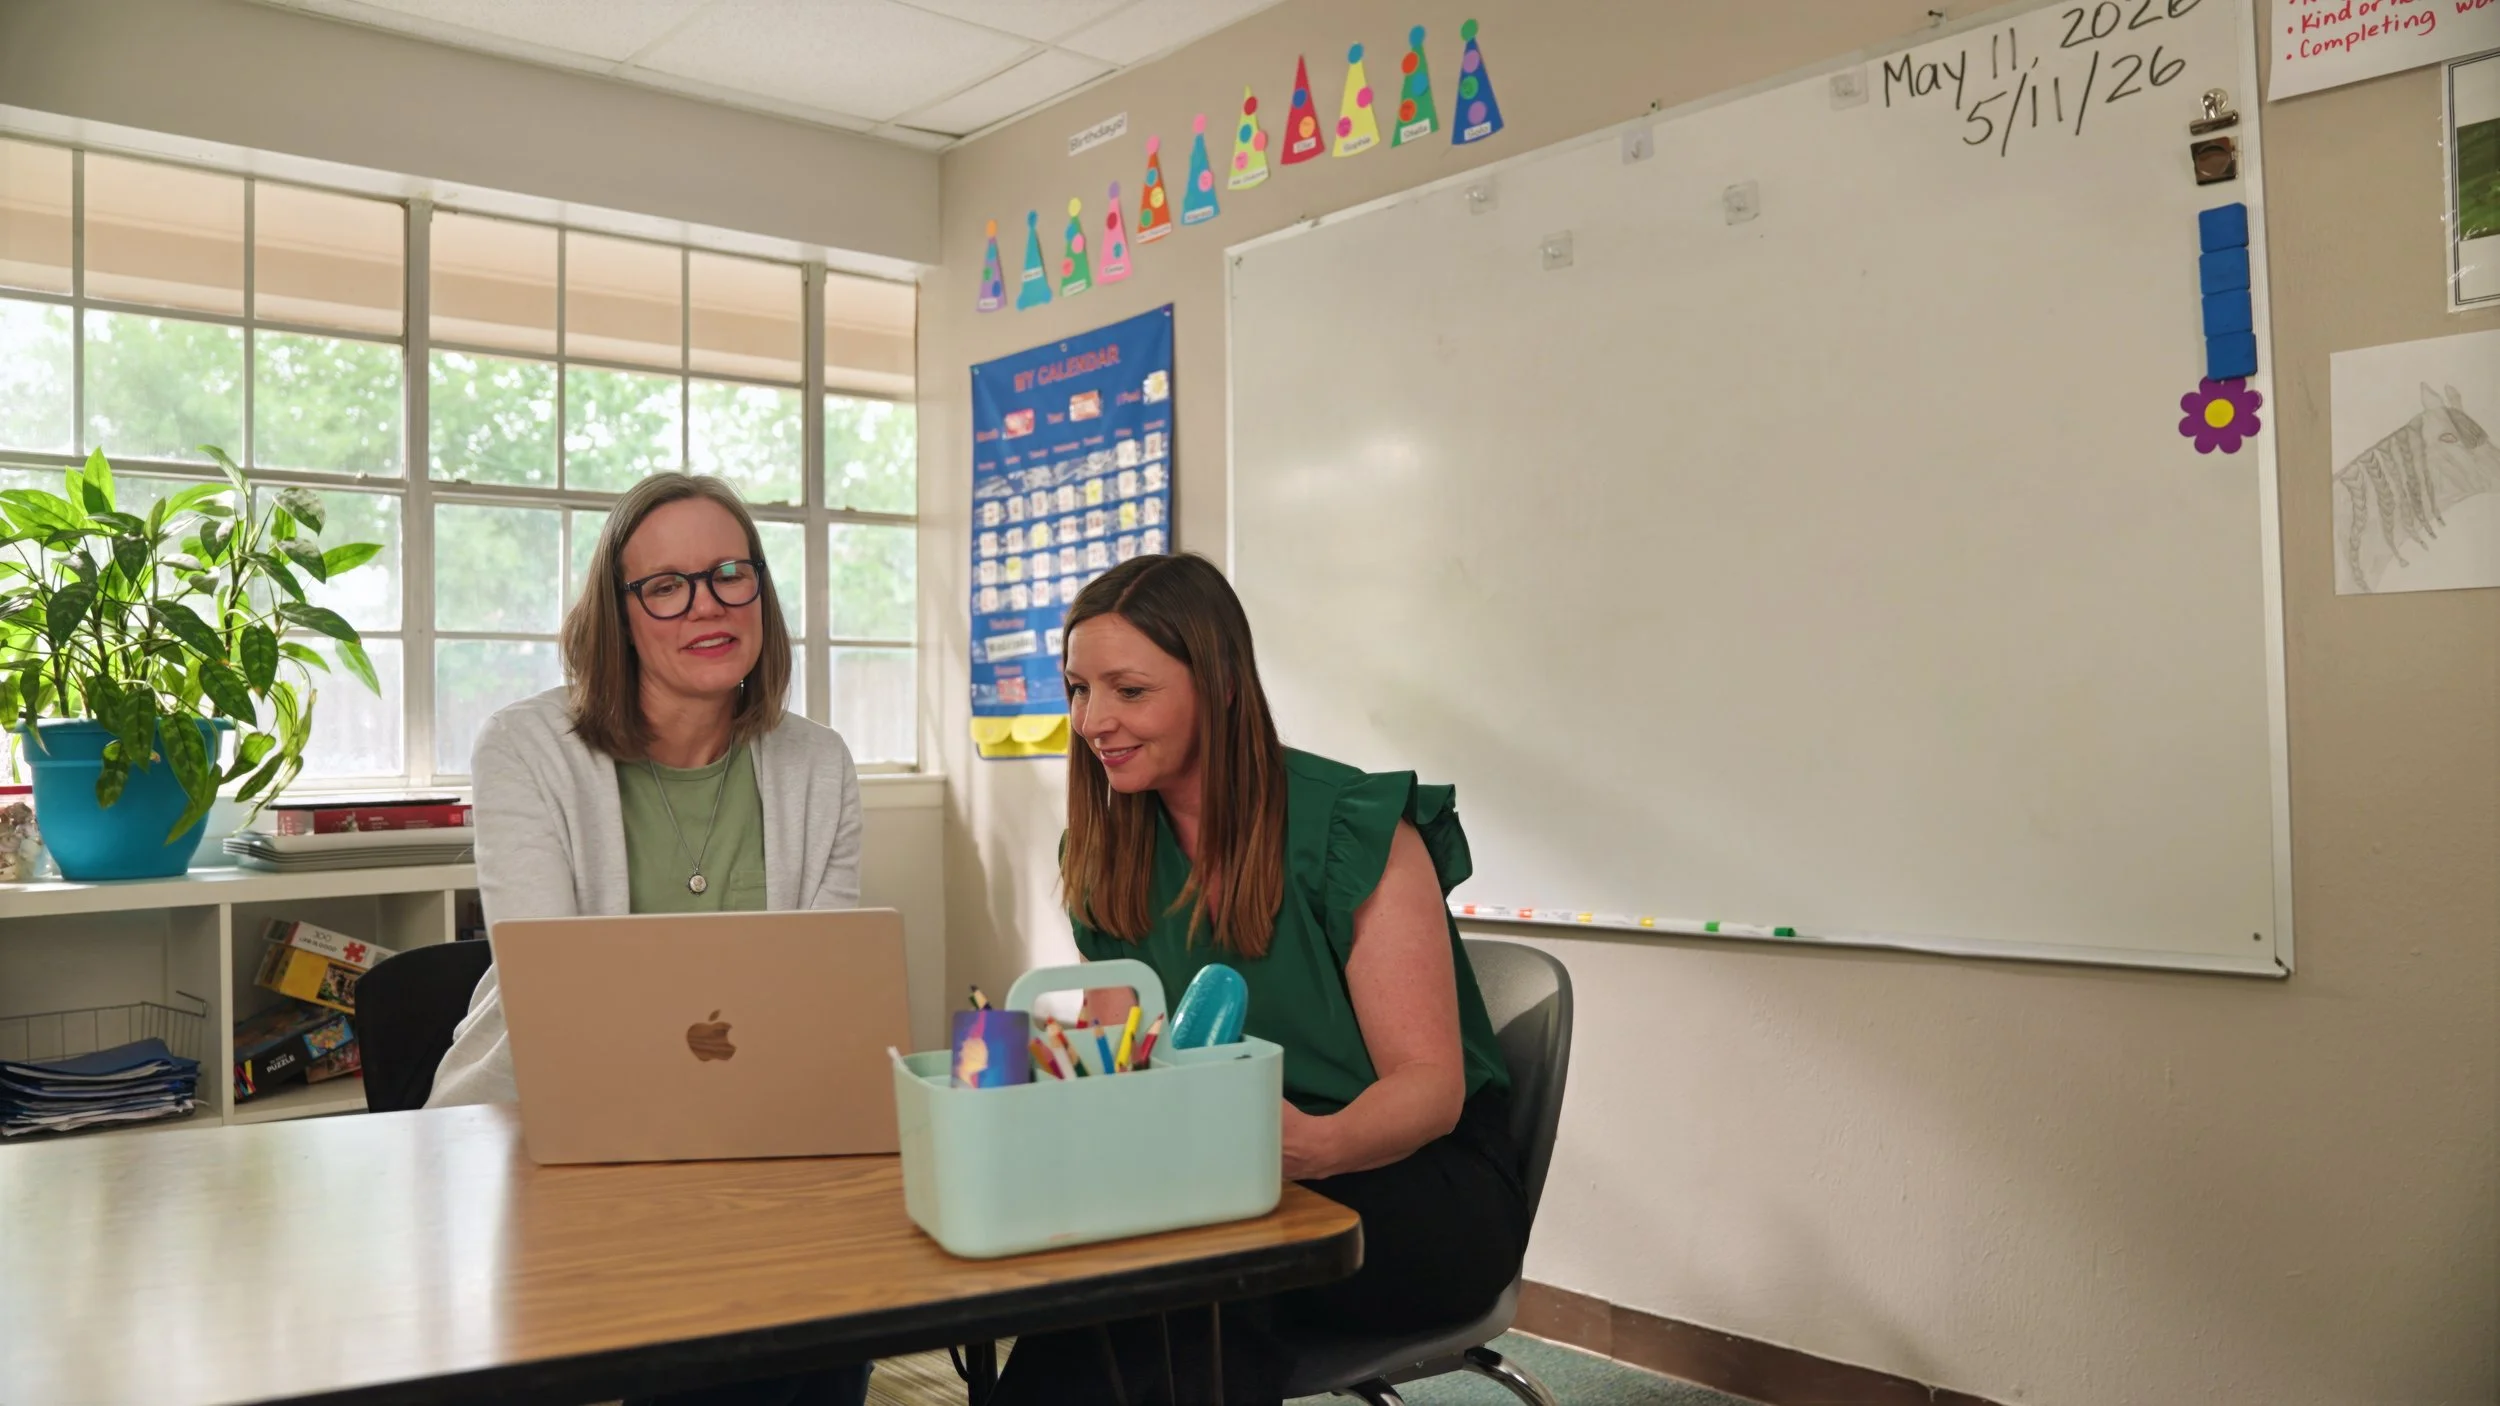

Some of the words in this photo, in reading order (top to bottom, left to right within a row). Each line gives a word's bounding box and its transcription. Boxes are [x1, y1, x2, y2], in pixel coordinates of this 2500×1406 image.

[2300, 11, 2436, 58] Completing
[2302, 0, 2352, 33] Kind
[2359, 0, 2380, 16] or
[1883, 50, 1966, 110] May
[1992, 27, 2039, 79] 11,
[1963, 46, 2186, 157] 5/11/26
[1013, 370, 1034, 393] MY
[1038, 344, 1120, 385] CALENDAR
[266, 1054, 295, 1073] PUZZLE
